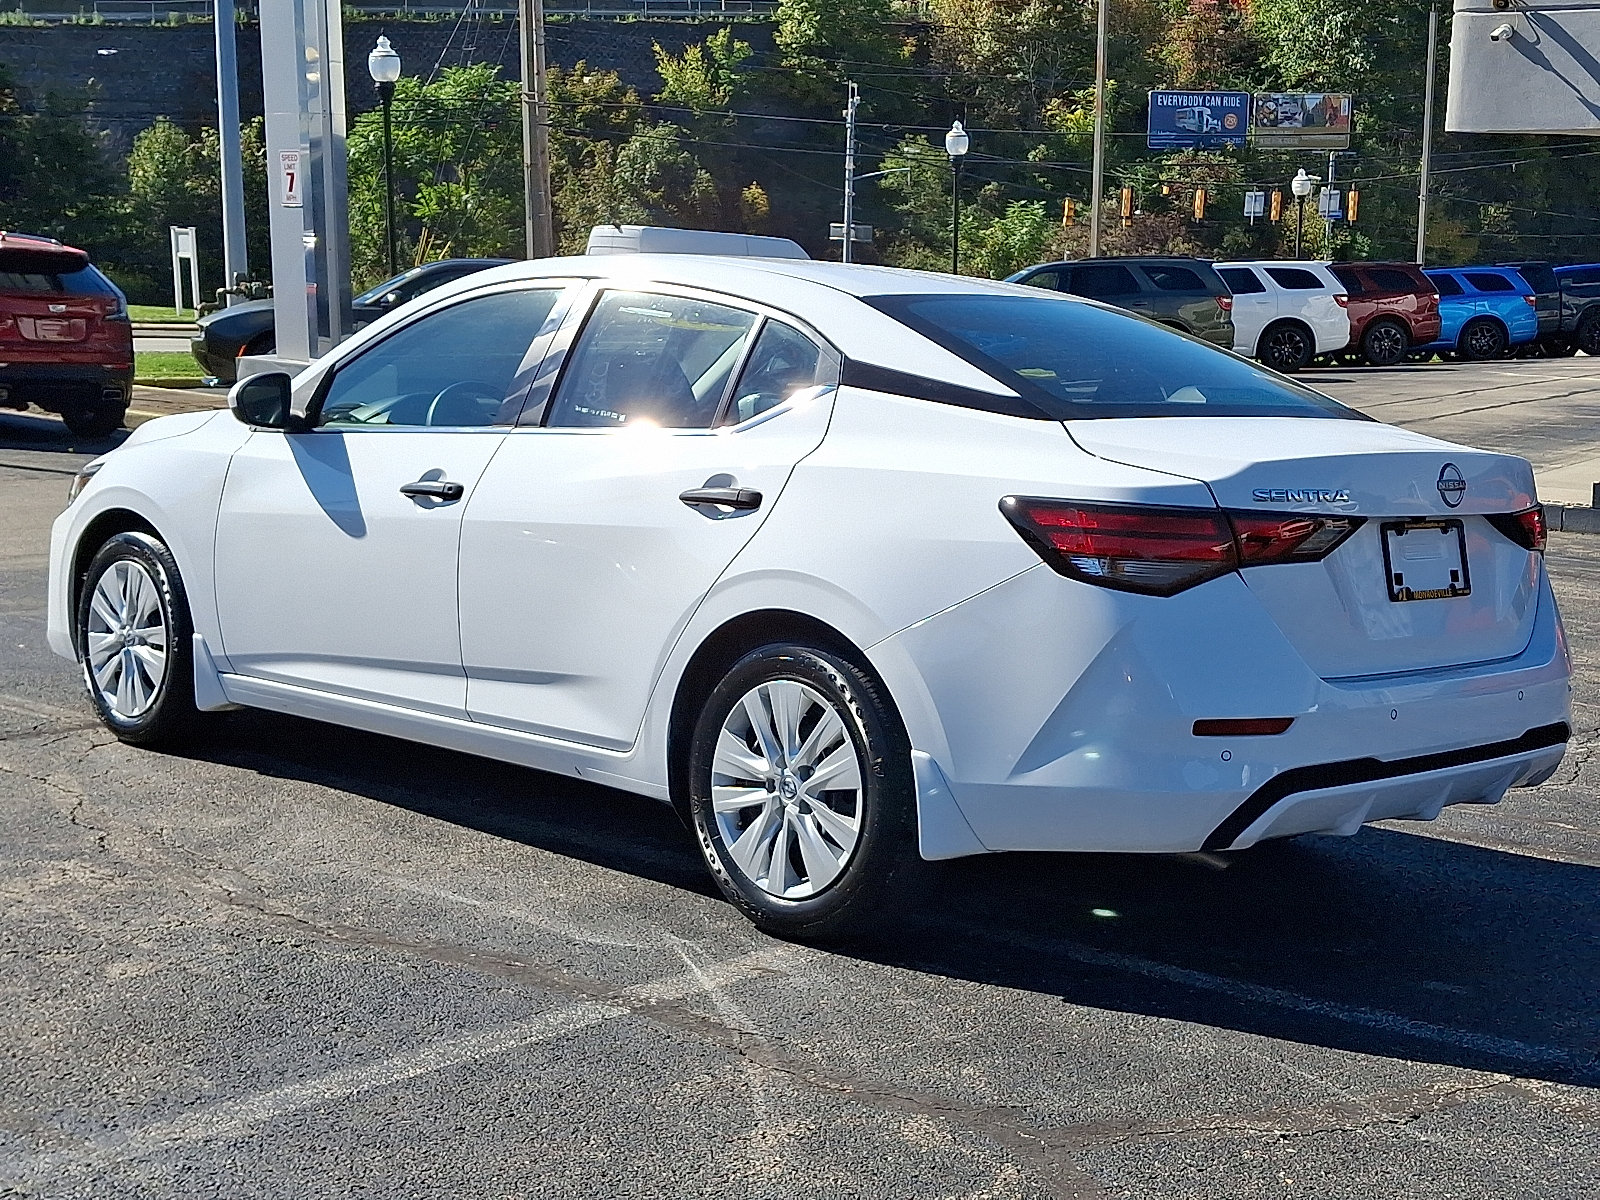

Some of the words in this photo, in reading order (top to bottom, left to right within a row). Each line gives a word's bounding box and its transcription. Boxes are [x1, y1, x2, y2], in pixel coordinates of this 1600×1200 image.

[1157, 95, 1204, 106] EVERYBODY
[1205, 96, 1221, 107] CAN
[1223, 97, 1241, 107] RIDE
[286, 172, 294, 192] 7
[1438, 481, 1466, 489] NISSAN
[1252, 488, 1350, 502] SENTRA
[1413, 588, 1453, 600] MONROEVILLE
